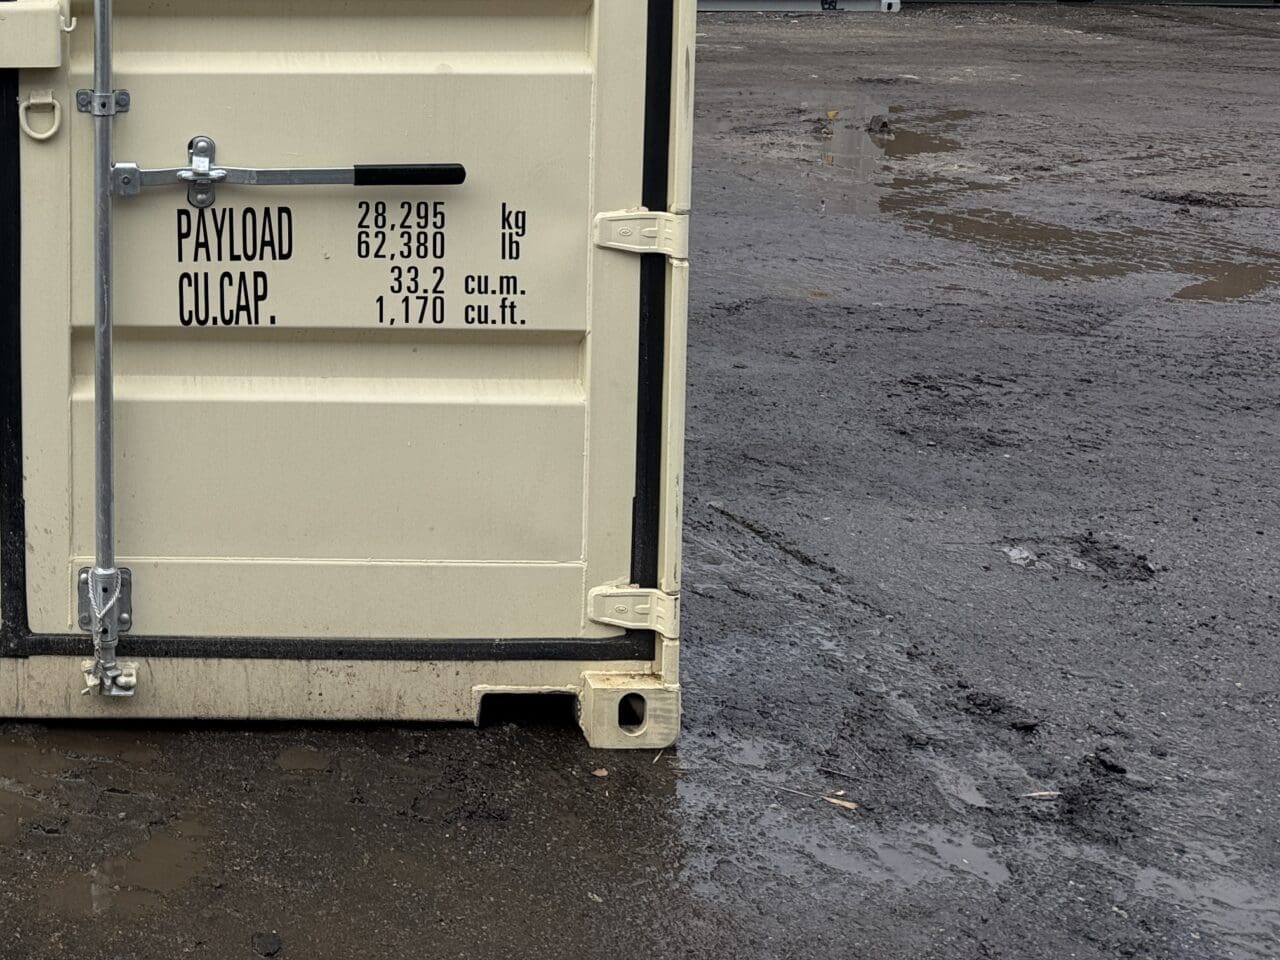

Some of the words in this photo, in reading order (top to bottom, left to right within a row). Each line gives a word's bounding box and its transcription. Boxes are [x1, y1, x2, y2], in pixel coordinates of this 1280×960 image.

[177, 206, 293, 262] PAYLOAD
[357, 201, 446, 231] 28,295
[502, 203, 526, 236] kg
[357, 231, 445, 261] 62,380
[502, 233, 519, 259] lb
[179, 271, 276, 326] CU.CAP.
[390, 266, 445, 294] 33.2
[464, 273, 526, 295] cu.m.
[376, 296, 445, 326] 1,170
[464, 299, 526, 325] cu.ft.
